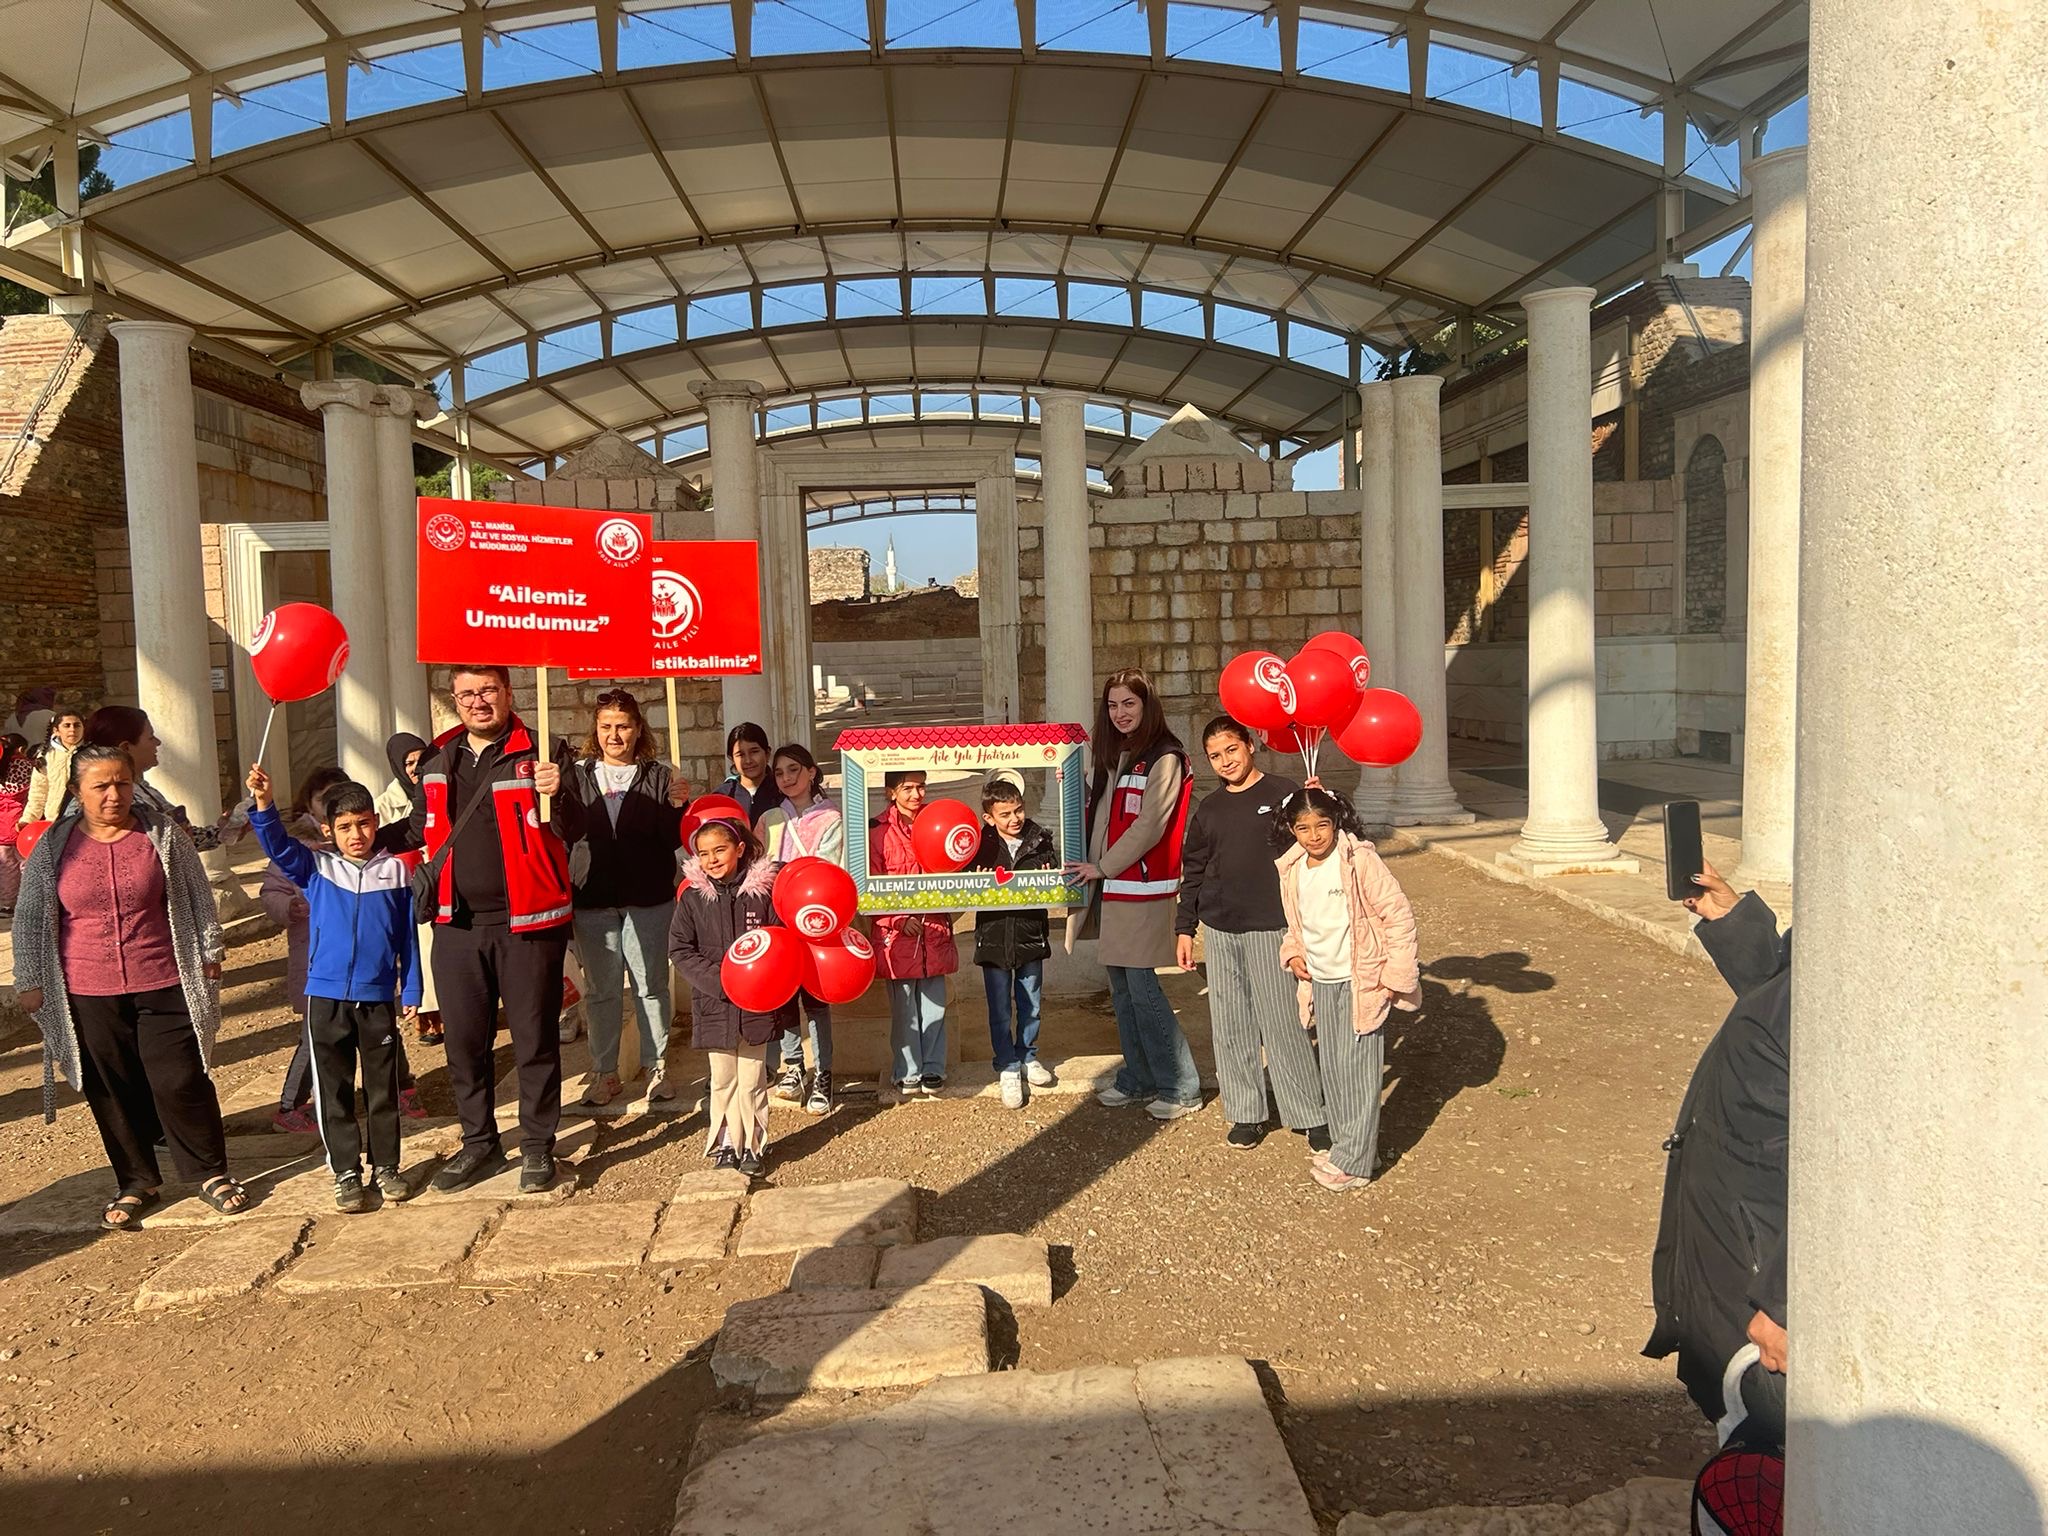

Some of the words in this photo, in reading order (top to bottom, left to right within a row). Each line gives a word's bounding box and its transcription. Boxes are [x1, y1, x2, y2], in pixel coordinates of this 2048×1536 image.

[485, 521, 515, 531] MANİSA
[470, 531, 488, 540] AİLE
[489, 533, 500, 541] VE
[501, 533, 530, 543] SOSYAL
[531, 535, 574, 546] HİZMETLER
[654, 640, 679, 649] AİLE
[681, 624, 700, 643] YILI
[928, 749, 949, 765] Aile
[867, 879, 915, 893] AİLEMİZ
[917, 877, 992, 891] UMUDUMUZ
[1017, 873, 1065, 888] MANİSA
